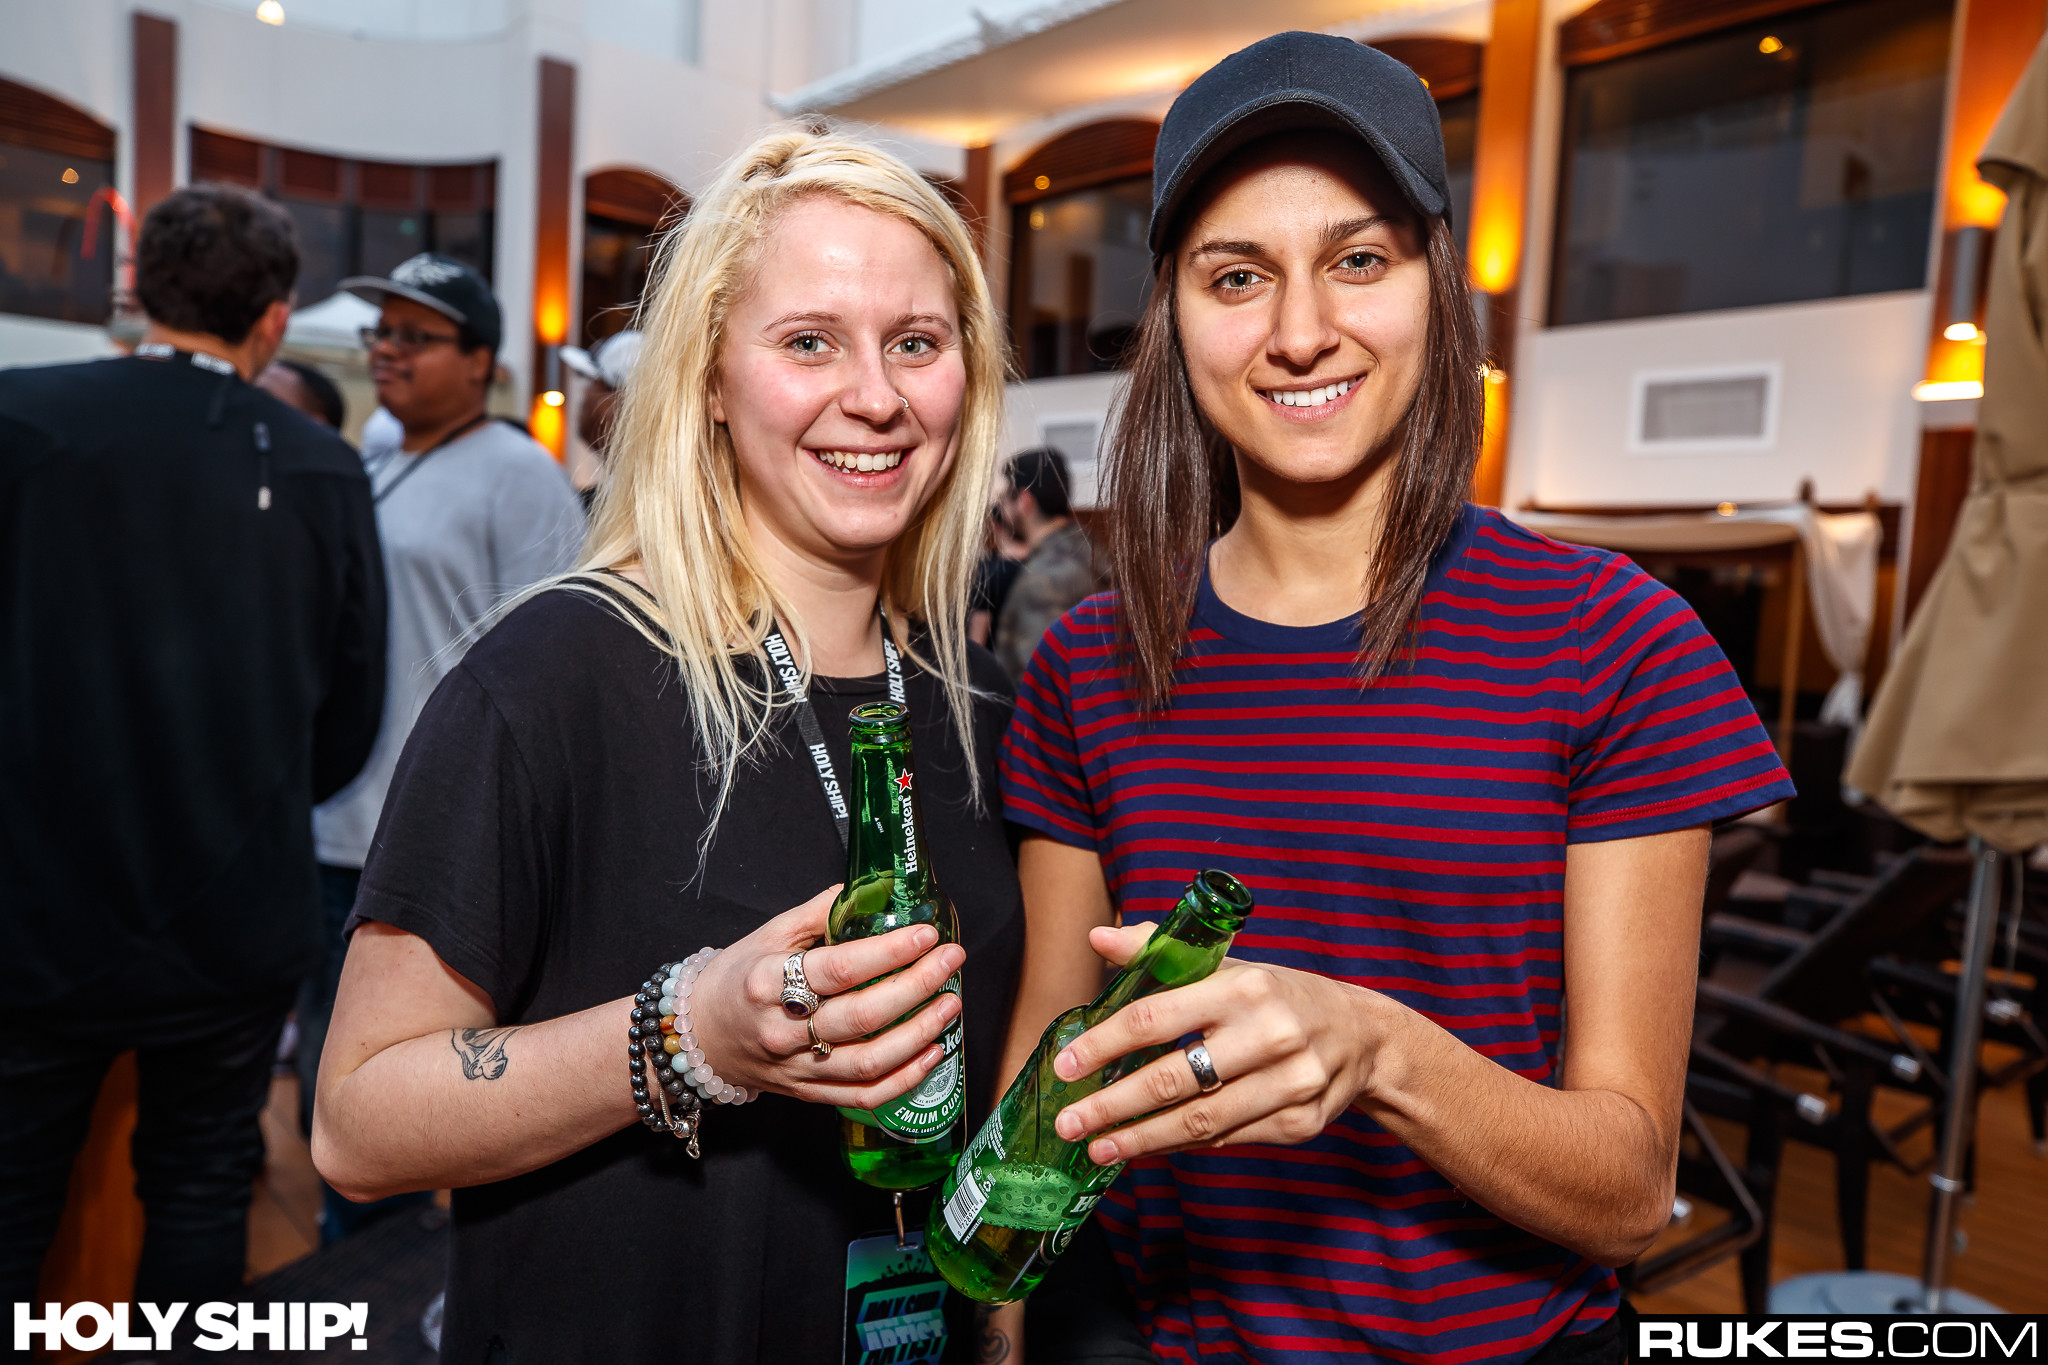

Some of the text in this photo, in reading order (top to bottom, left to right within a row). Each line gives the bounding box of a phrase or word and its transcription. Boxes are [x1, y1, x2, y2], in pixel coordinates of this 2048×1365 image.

[764, 633, 794, 666] HOLY
[888, 670, 906, 704] HOLY
[809, 743, 849, 819] HOLY SHIP!
[902, 795, 918, 875] Heineken
[894, 1106, 938, 1125] EMIUM
[941, 1065, 964, 1117] QUALITY
